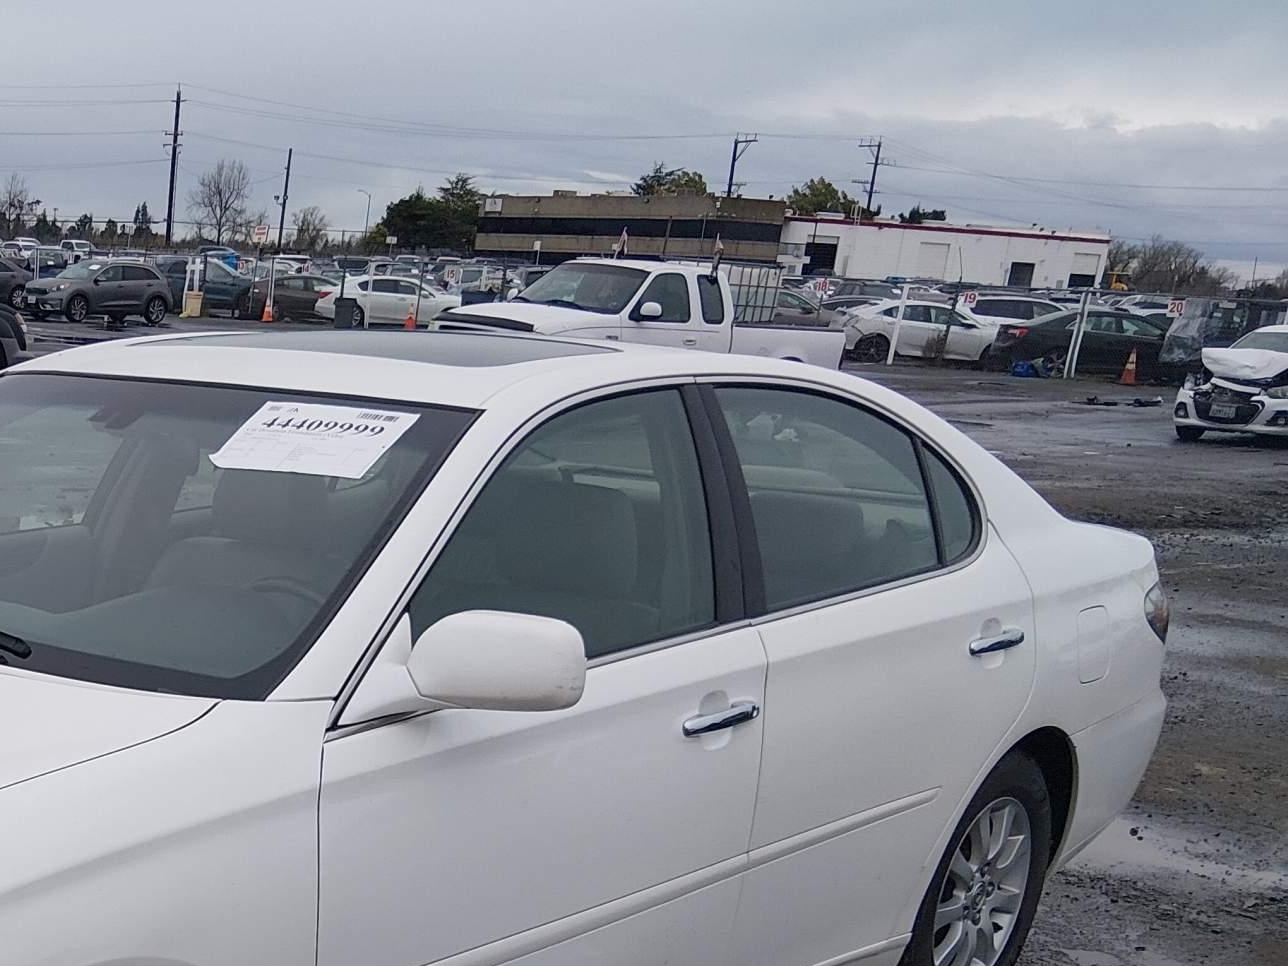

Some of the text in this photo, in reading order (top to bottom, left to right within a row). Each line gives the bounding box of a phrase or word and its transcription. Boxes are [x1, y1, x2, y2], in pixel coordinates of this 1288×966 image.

[446, 269, 456, 279] 15
[963, 292, 977, 304] 19
[1169, 302, 1184, 313] 20
[261, 416, 385, 437] 44409999
